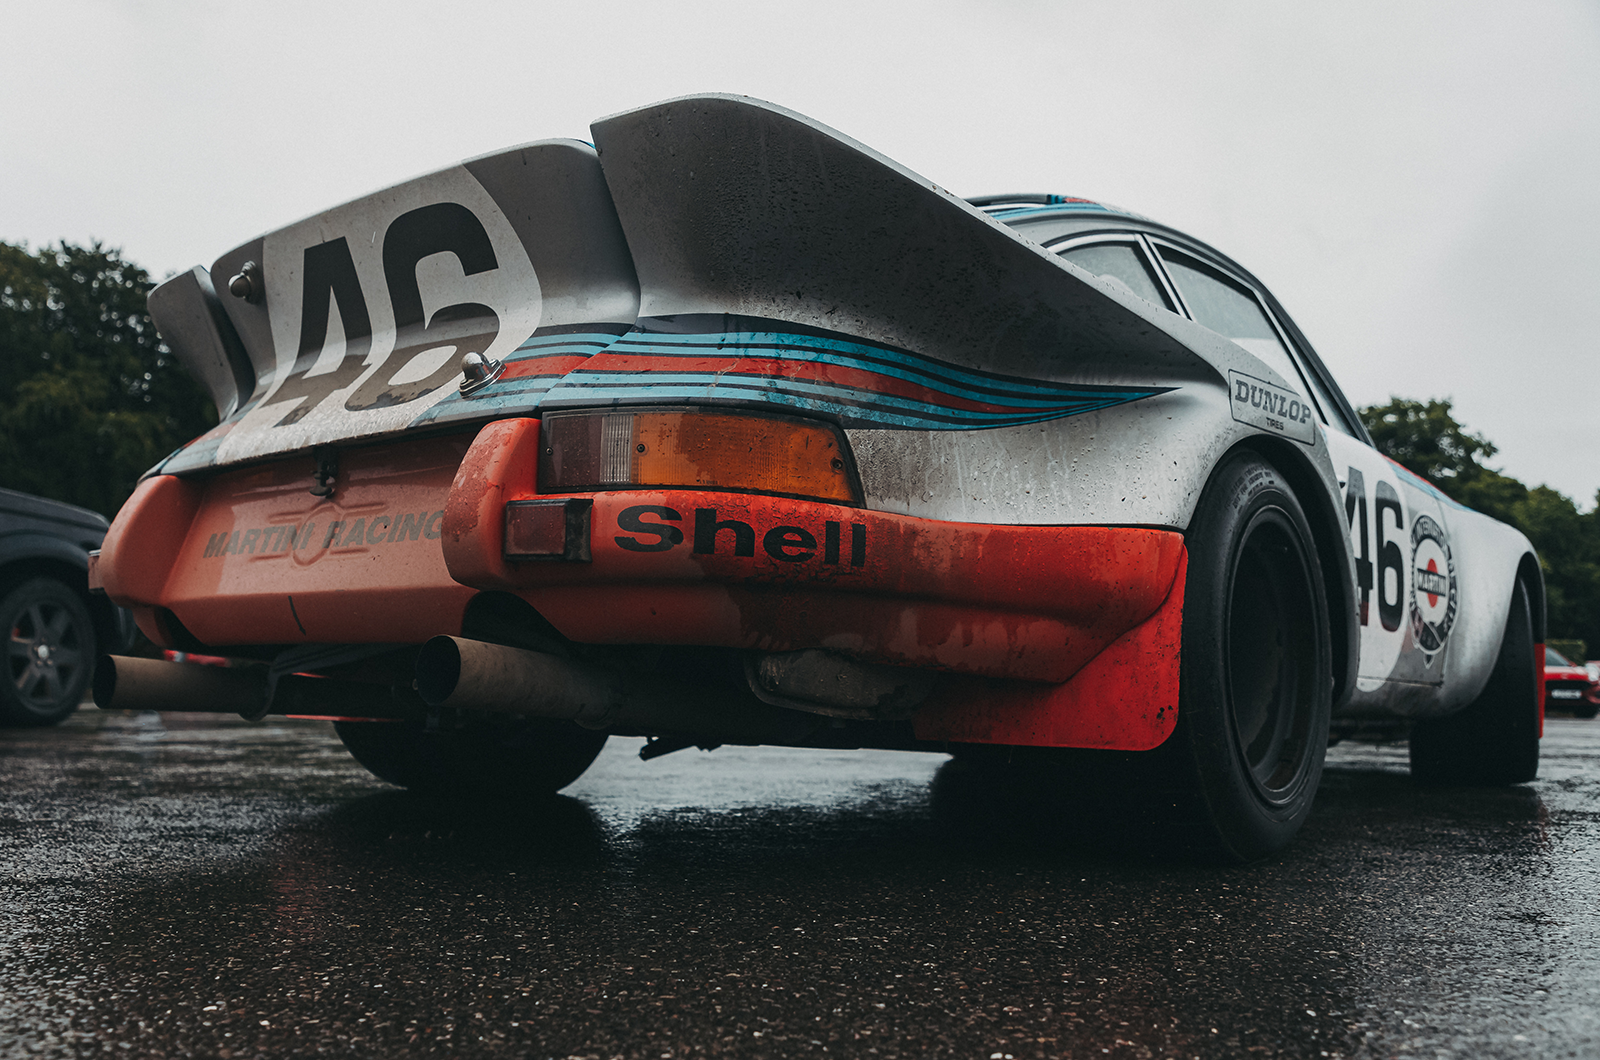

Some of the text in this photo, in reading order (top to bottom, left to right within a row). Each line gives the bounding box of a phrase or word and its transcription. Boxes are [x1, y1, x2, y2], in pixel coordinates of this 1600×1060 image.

[257, 202, 499, 427] 46
[1235, 379, 1311, 424] DUNLOP
[203, 510, 445, 558] MARTINI RACING
[614, 504, 867, 568] Shell
[1345, 466, 1404, 632] 46
